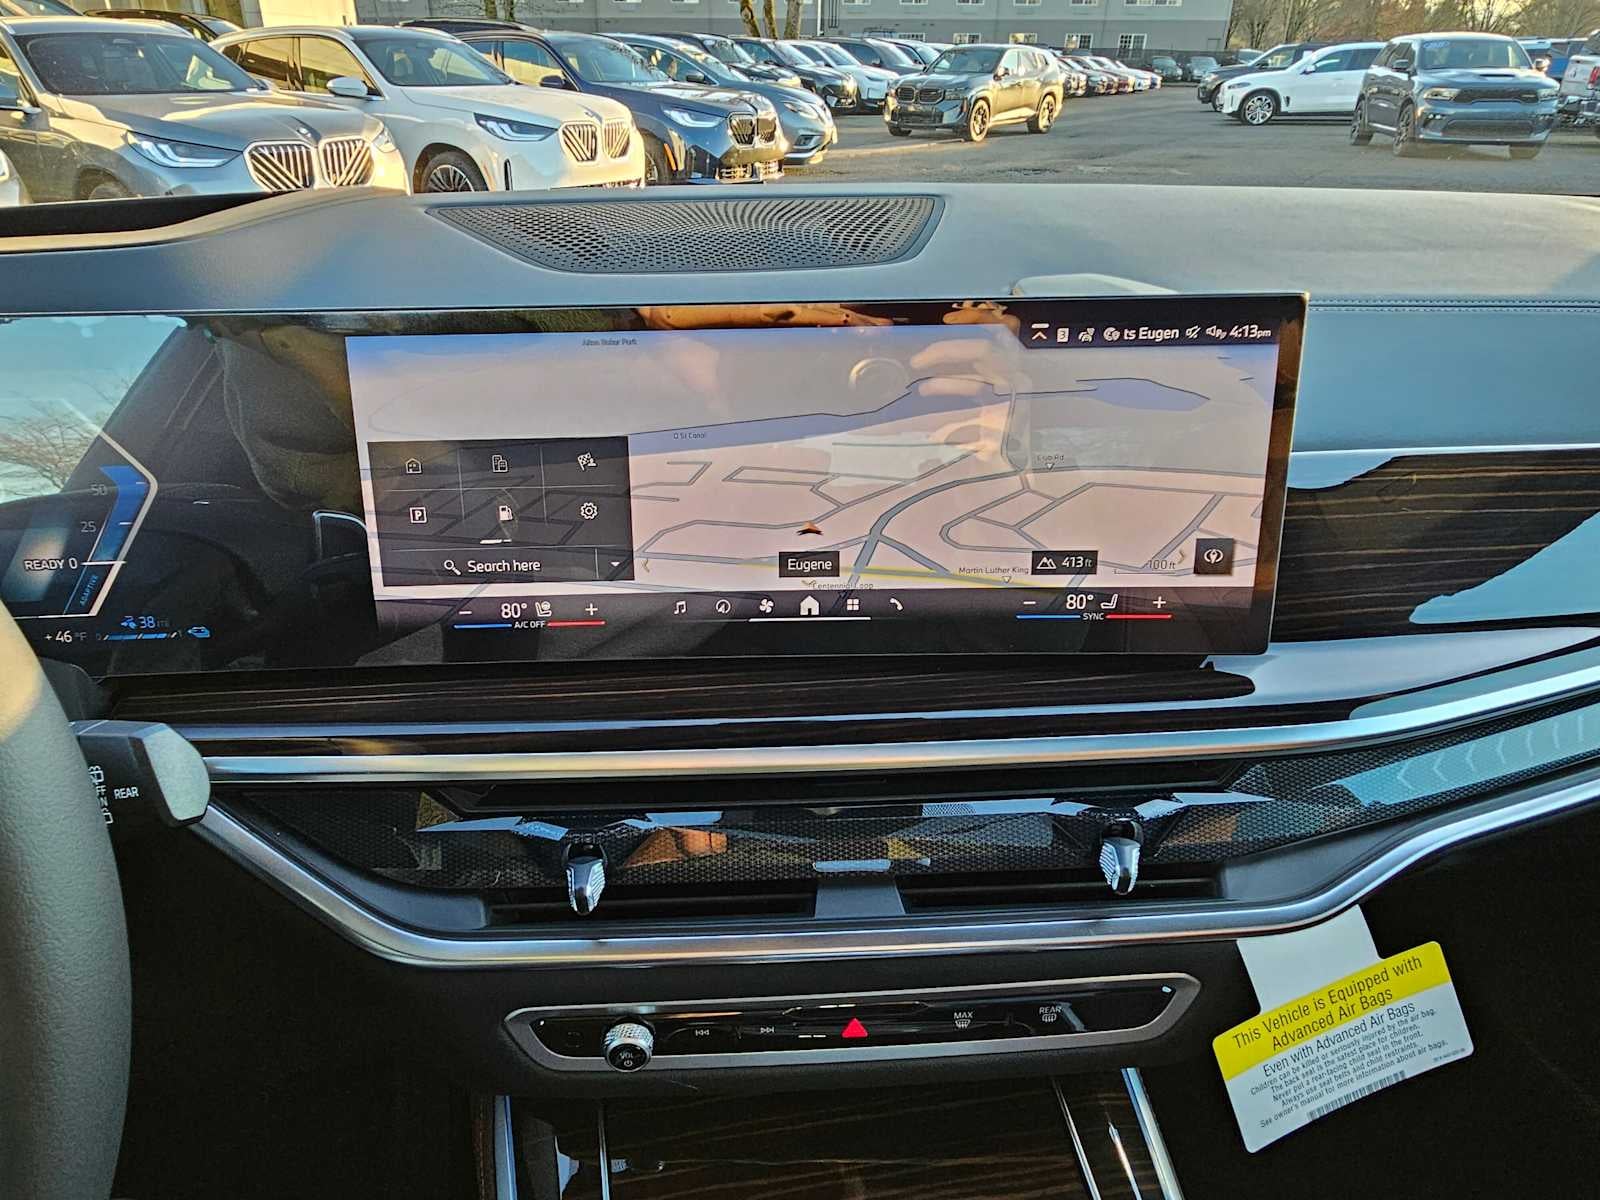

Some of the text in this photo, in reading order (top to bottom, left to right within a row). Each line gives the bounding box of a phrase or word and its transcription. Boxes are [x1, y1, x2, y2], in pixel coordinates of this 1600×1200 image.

[1138, 326, 1179, 343] Eugen
[90, 484, 107, 496] 50
[80, 521, 96, 533] 25
[24, 558, 78, 571] READY 0
[467, 559, 541, 574] Search here
[787, 558, 833, 573] Eugene
[958, 566, 1029, 576] Martin Luther King
[139, 616, 156, 629] 38
[1082, 611, 1105, 621] SYNC
[513, 620, 546, 630] A/C OFF
[113, 786, 139, 800] REAR
[1039, 1005, 1062, 1014] REAR
[1232, 956, 1422, 1048] This Vehicle is Equipped with
[953, 1011, 974, 1020] MAX
[1272, 989, 1392, 1051] Advanced Air Bags
[1263, 1002, 1415, 1077] Even with Advanced Air Bags
[1250, 1077, 1277, 1095] Children
[1278, 1070, 1290, 1081] can
[1291, 1066, 1300, 1074] be
[1301, 1055, 1319, 1068] killed
[1320, 1052, 1328, 1060] or
[1329, 1039, 1360, 1056] seriously
[1362, 1026, 1386, 1041] injured
[1386, 1023, 1395, 1031] by
[1397, 1016, 1408, 1027] the
[1410, 1013, 1419, 1022] air
[1270, 1083, 1283, 1093] The
[1283, 1075, 1300, 1087] back
[1301, 1067, 1315, 1079] seat
[1324, 1059, 1335, 1067] the
[1336, 1048, 1357, 1061] safest
[1358, 1041, 1379, 1053] place
[1377, 1035, 1387, 1045] for
[1272, 1088, 1291, 1102] Never
[1293, 1081, 1304, 1093] put
[1348, 1053, 1365, 1066] child
[1366, 1046, 1381, 1057] seat
[1390, 1039, 1402, 1048] the
[1260, 1118, 1272, 1127] See
[1297, 1089, 1324, 1106] manual
[1324, 1085, 1334, 1094] for
[1336, 1077, 1354, 1088] more
[1355, 1060, 1395, 1080] information
[1396, 1050, 1416, 1063] about
[1417, 1046, 1426, 1055] air
[1281, 1092, 1304, 1107] Always
[1305, 1085, 1317, 1095] use
[1318, 1077, 1332, 1088] seat
[1333, 1070, 1351, 1081] belts
[1352, 1062, 1365, 1073] and
[1366, 1055, 1382, 1067] child
